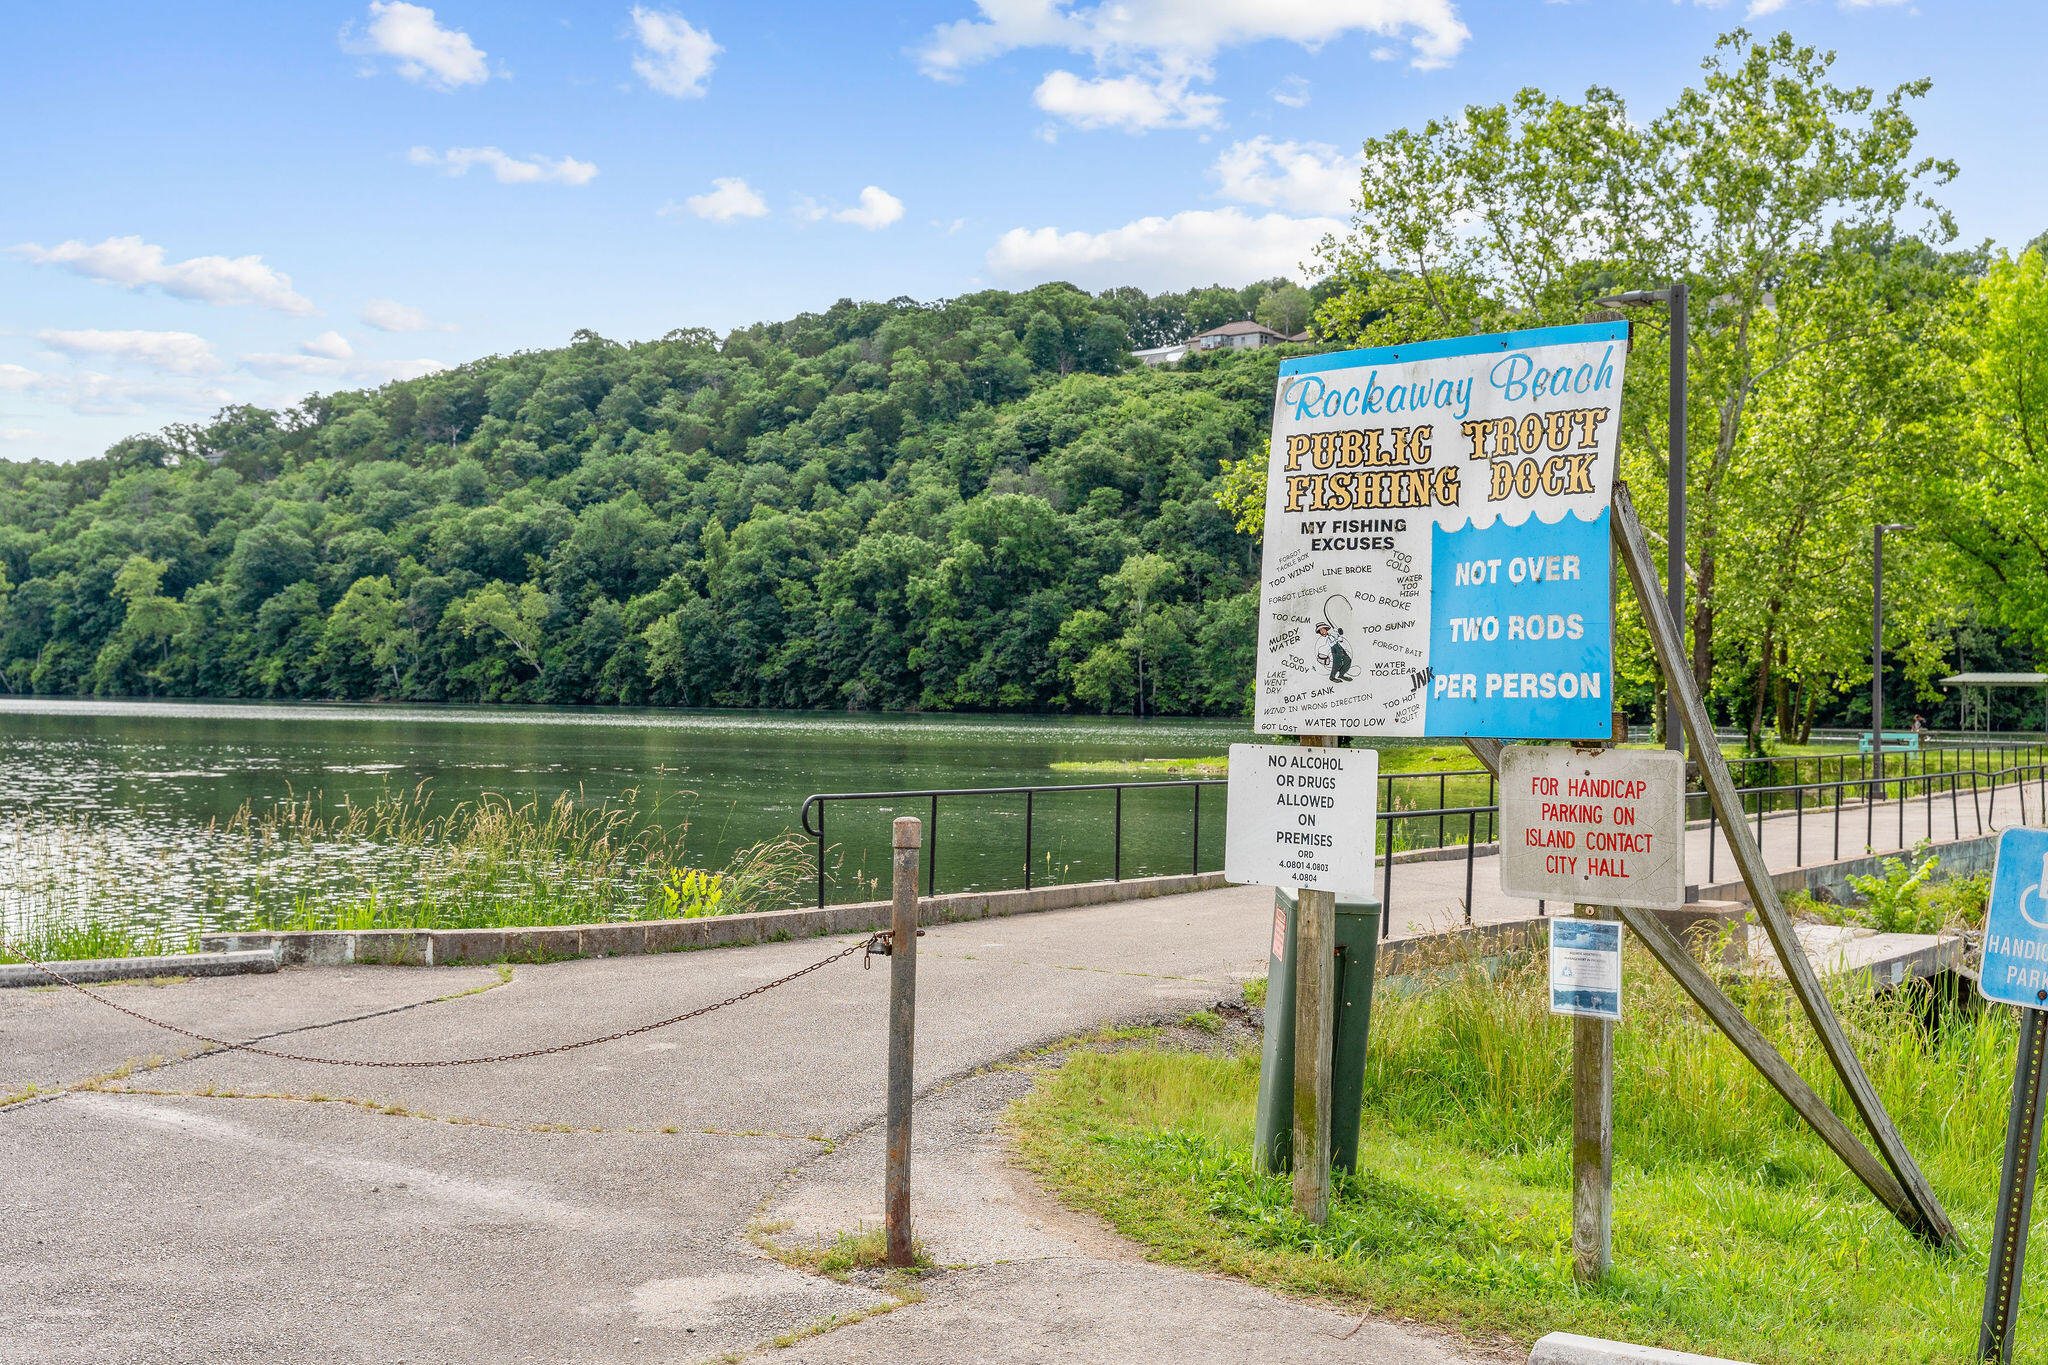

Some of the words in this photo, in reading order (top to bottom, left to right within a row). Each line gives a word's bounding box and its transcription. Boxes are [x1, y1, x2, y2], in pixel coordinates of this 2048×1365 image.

[1284, 370, 1474, 421] Rockaway
[1490, 344, 1614, 402] Beach
[1284, 424, 1433, 471] PUBLIC
[1461, 407, 1611, 461] TROUT
[1284, 466, 1461, 513] FISHING
[1488, 453, 1598, 502] DOCK
[1301, 521, 1327, 534] MY
[1332, 519, 1407, 534] FISHING
[1311, 537, 1395, 551] EXCUSES
[1277, 559, 1297, 572] TACKLE
[1298, 553, 1310, 562] BOX
[1279, 549, 1301, 562] FORGOT
[1393, 550, 1412, 563] TOO
[1322, 567, 1342, 576] LINE
[1346, 565, 1372, 574] BROKE
[1386, 560, 1410, 573] COLD
[1455, 559, 1501, 586] NOT
[1508, 555, 1581, 583] OVER
[1269, 576, 1286, 588] TOO
[1288, 562, 1315, 579] WINDY
[1397, 575, 1423, 583] WATER
[1269, 593, 1296, 605] FORGOT
[1297, 585, 1328, 598] LICENSE
[1355, 591, 1375, 602] ROD
[1379, 596, 1411, 611] BROKE
[1362, 625, 1381, 633] TOO
[1385, 620, 1415, 631] SUNNY
[1450, 616, 1499, 642] TWO
[1508, 614, 1584, 641] RODS
[1269, 628, 1300, 646] MUDDY
[1270, 635, 1300, 653] WATER
[1373, 640, 1404, 652] FORGOT
[1405, 648, 1423, 657] BAIT
[1281, 660, 1309, 673] CLOUDY
[1289, 654, 1304, 664] TOO
[1375, 661, 1405, 669] WATER
[1391, 667, 1416, 675] CLEAR
[1434, 673, 1477, 699] PER
[1486, 672, 1600, 698] PERSON
[1284, 692, 1307, 703] BOAT
[1311, 686, 1335, 698] SANK
[1383, 700, 1400, 709] TOO
[1402, 693, 1416, 703] HOT
[1264, 707, 1286, 715] WIND
[1301, 703, 1328, 711] WRONG
[1331, 693, 1373, 708] DIRECTION
[1396, 704, 1420, 717] MOTOR
[1305, 719, 1337, 728] WATER
[1341, 718, 1360, 728] TOO
[1364, 718, 1385, 726] LOW
[1400, 712, 1418, 724] QUIT
[1268, 755, 1287, 767] NO
[1291, 756, 1343, 771] ALCOHOL
[1276, 775, 1294, 787] OR
[1298, 776, 1335, 789] DRUGS
[1532, 777, 1559, 795] FOR
[1568, 779, 1647, 799] HANDICAP
[1277, 794, 1334, 808] ALLOWED
[1298, 814, 1316, 826] ON
[1542, 803, 1602, 824] PARKING
[1614, 807, 1635, 825] ON
[1276, 832, 1333, 847] PREMISES
[1526, 829, 1575, 849] ISLAND
[1586, 832, 1652, 853] CONTACT
[1298, 850, 1313, 858] ORD
[1279, 860, 1304, 869] 4.0801
[1306, 863, 1328, 871] 4.0803
[1546, 855, 1577, 874] CITY
[1589, 858, 1629, 878] HALL
[1292, 873, 1317, 882] 4.0804
